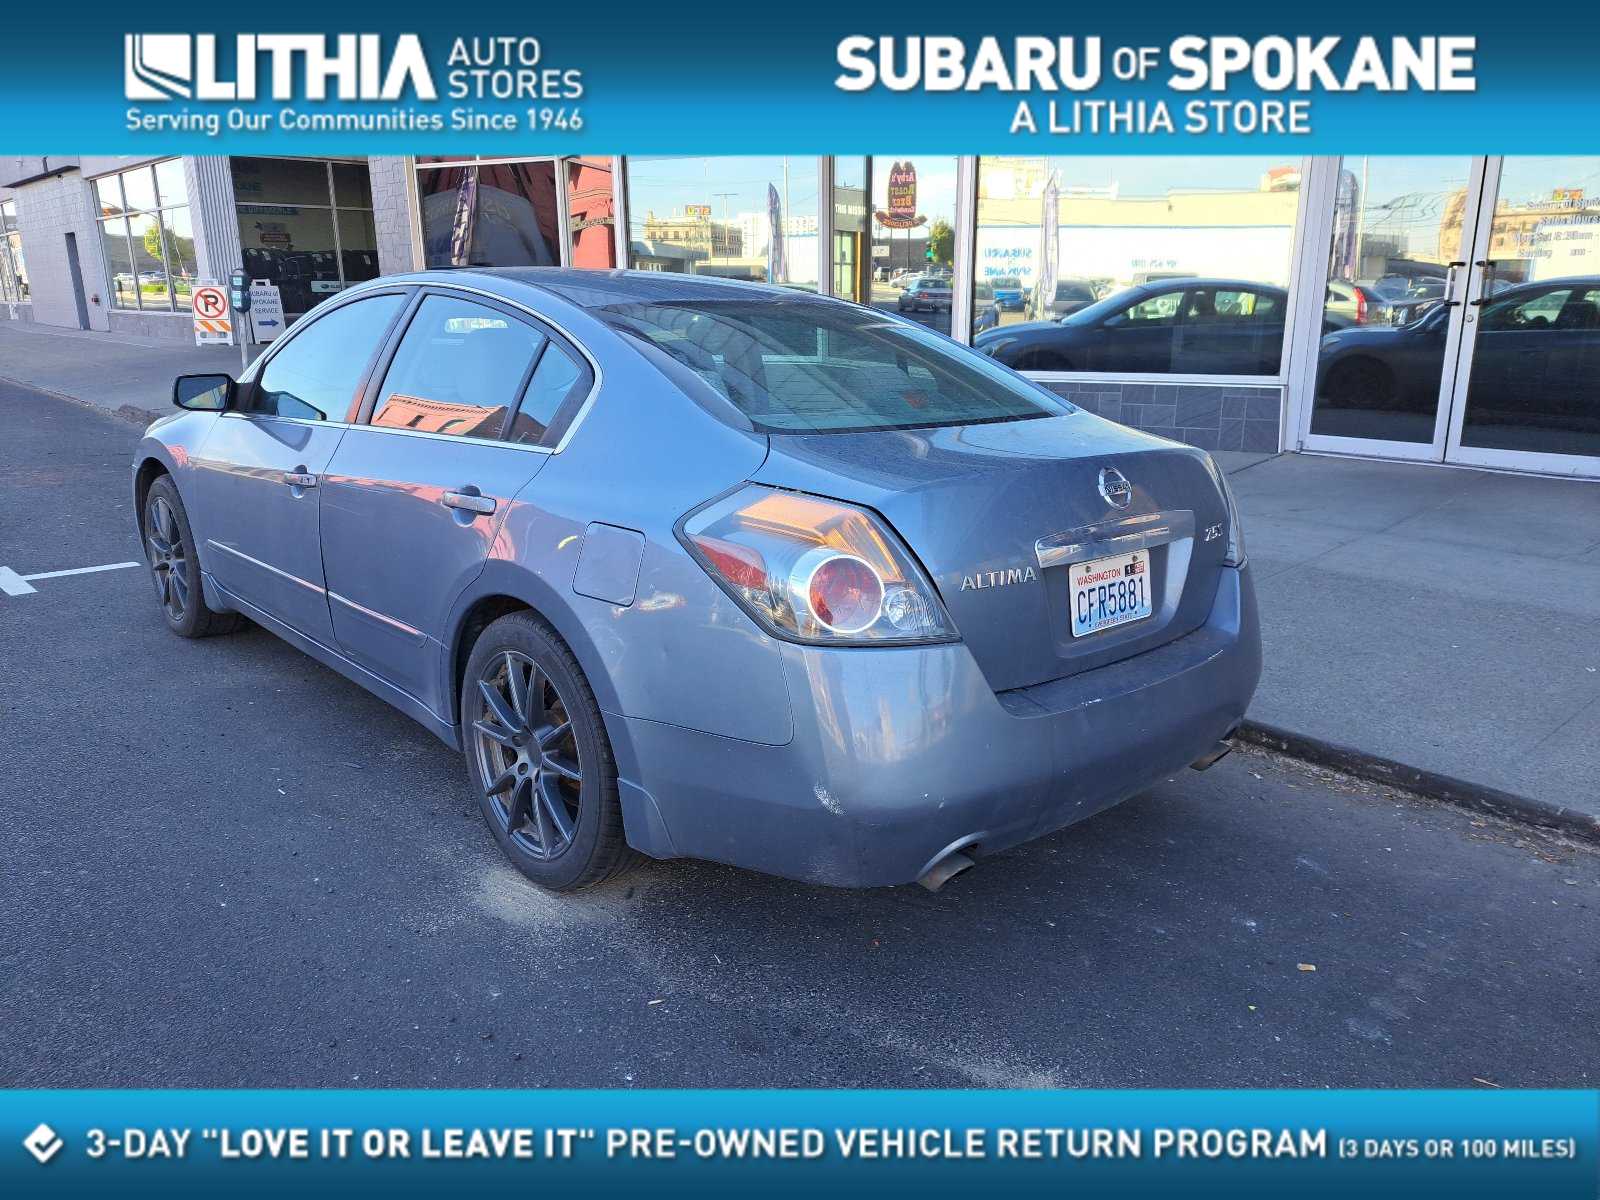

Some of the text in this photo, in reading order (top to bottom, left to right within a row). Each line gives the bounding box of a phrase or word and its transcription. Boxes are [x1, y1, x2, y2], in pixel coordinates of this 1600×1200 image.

[959, 566, 1038, 592] ALTIMA
[1076, 567, 1121, 587] WASHINGTON
[1077, 575, 1144, 625] CFR5881
